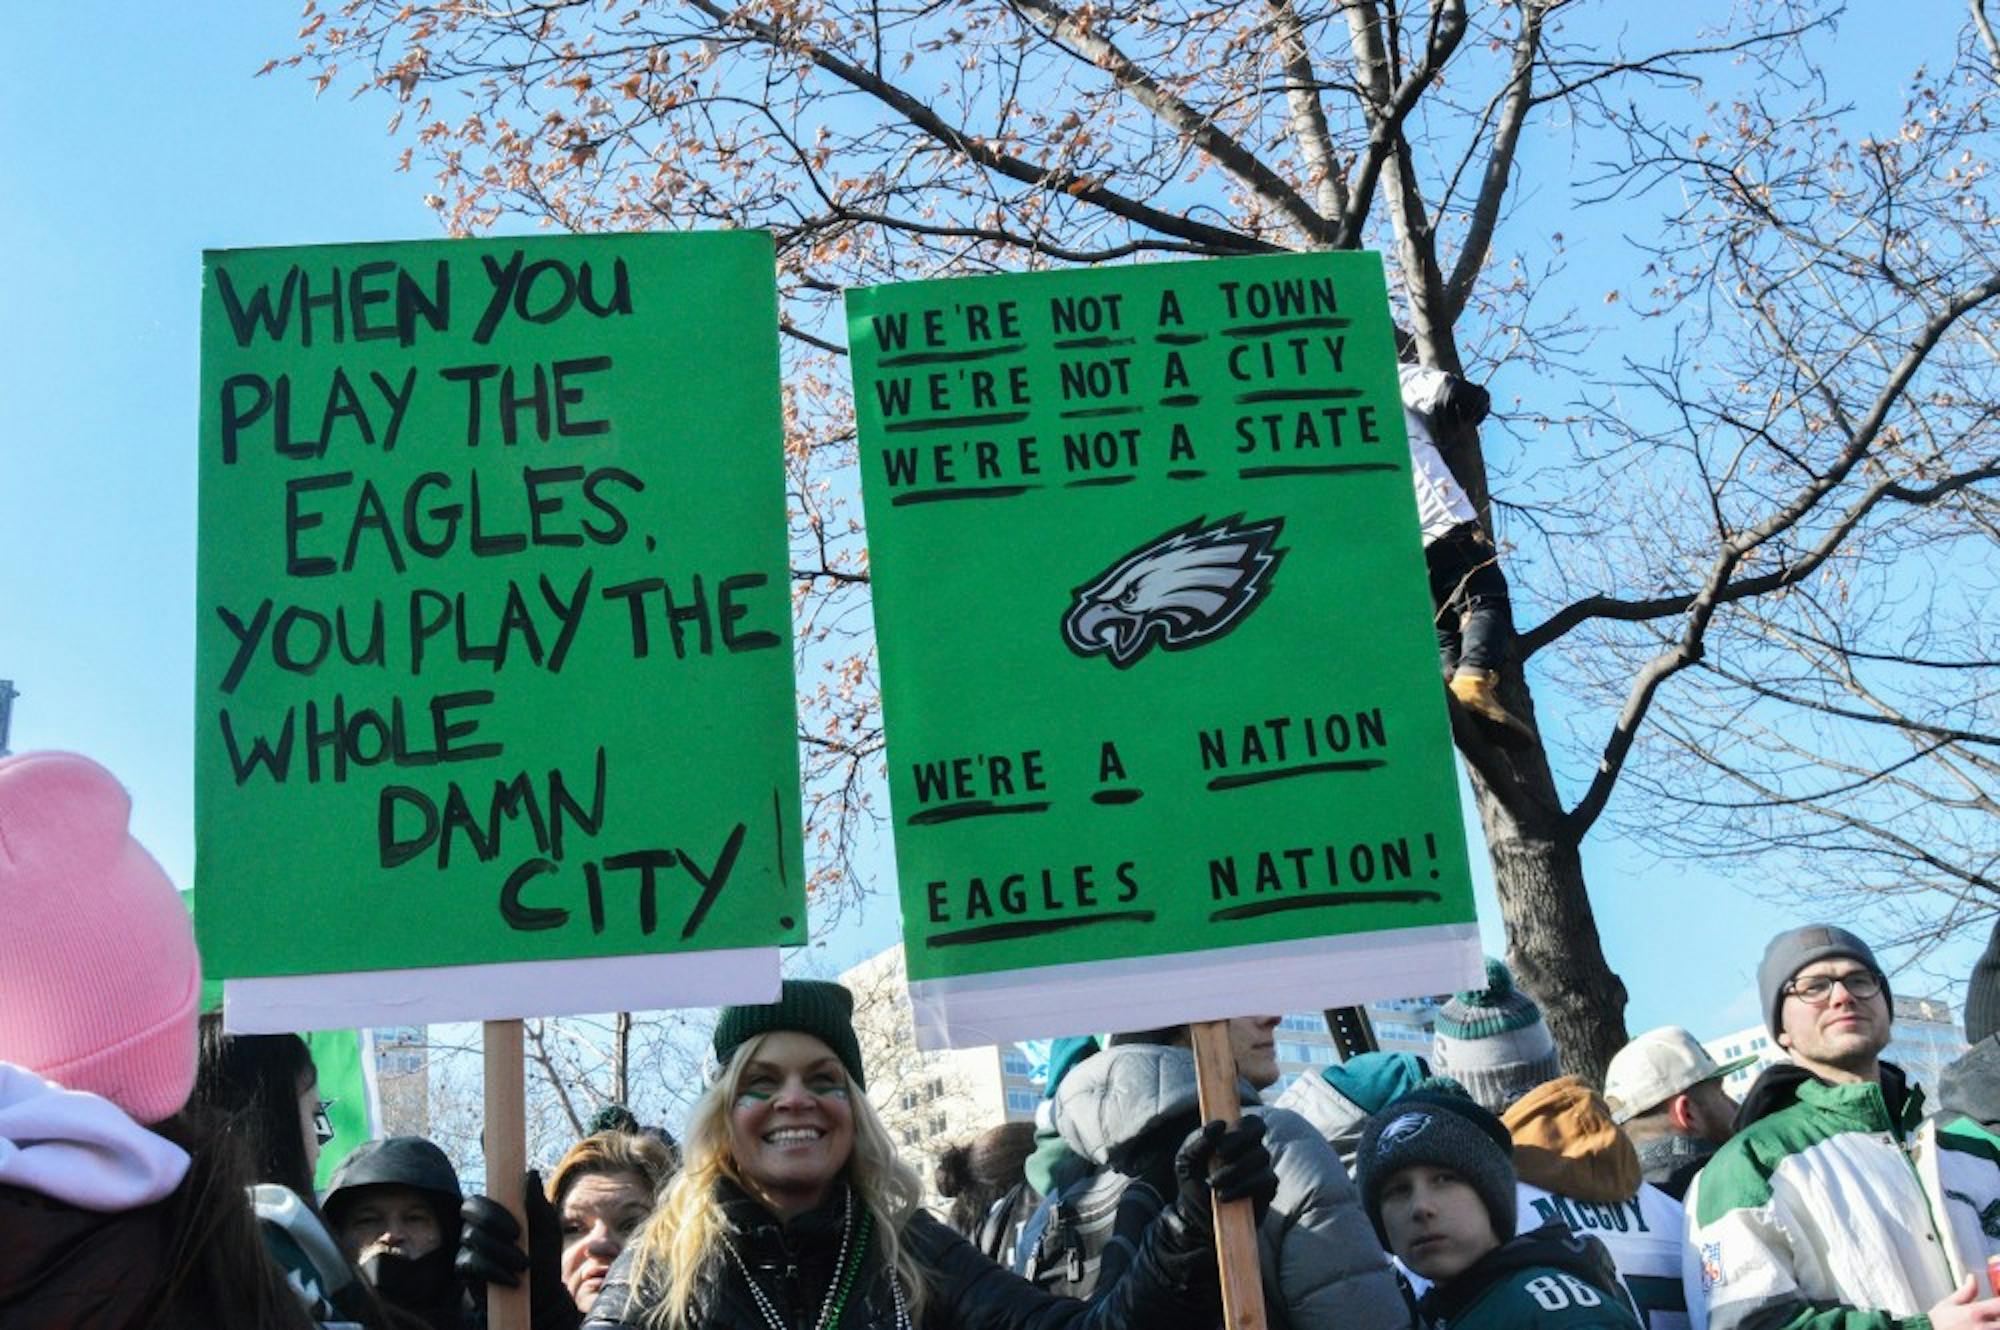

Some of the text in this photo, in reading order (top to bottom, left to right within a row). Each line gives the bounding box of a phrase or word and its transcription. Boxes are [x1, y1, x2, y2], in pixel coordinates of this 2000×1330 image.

[216, 250, 633, 347] WHEN YOU
[872, 277, 1338, 352] WE'RE NOT A TOWN
[220, 356, 613, 465] PLAY THE
[876, 336, 1346, 417] WE'RE NOT A CITY
[883, 406, 1381, 487] WE'RE NOT A STATE
[216, 567, 782, 694] YOU PLAY THE
[219, 690, 504, 786] WHOLE
[913, 708, 1388, 803] WE'RE A NATION
[379, 746, 606, 870] DAMN
[928, 833, 1440, 923] EAGLES NATION!
